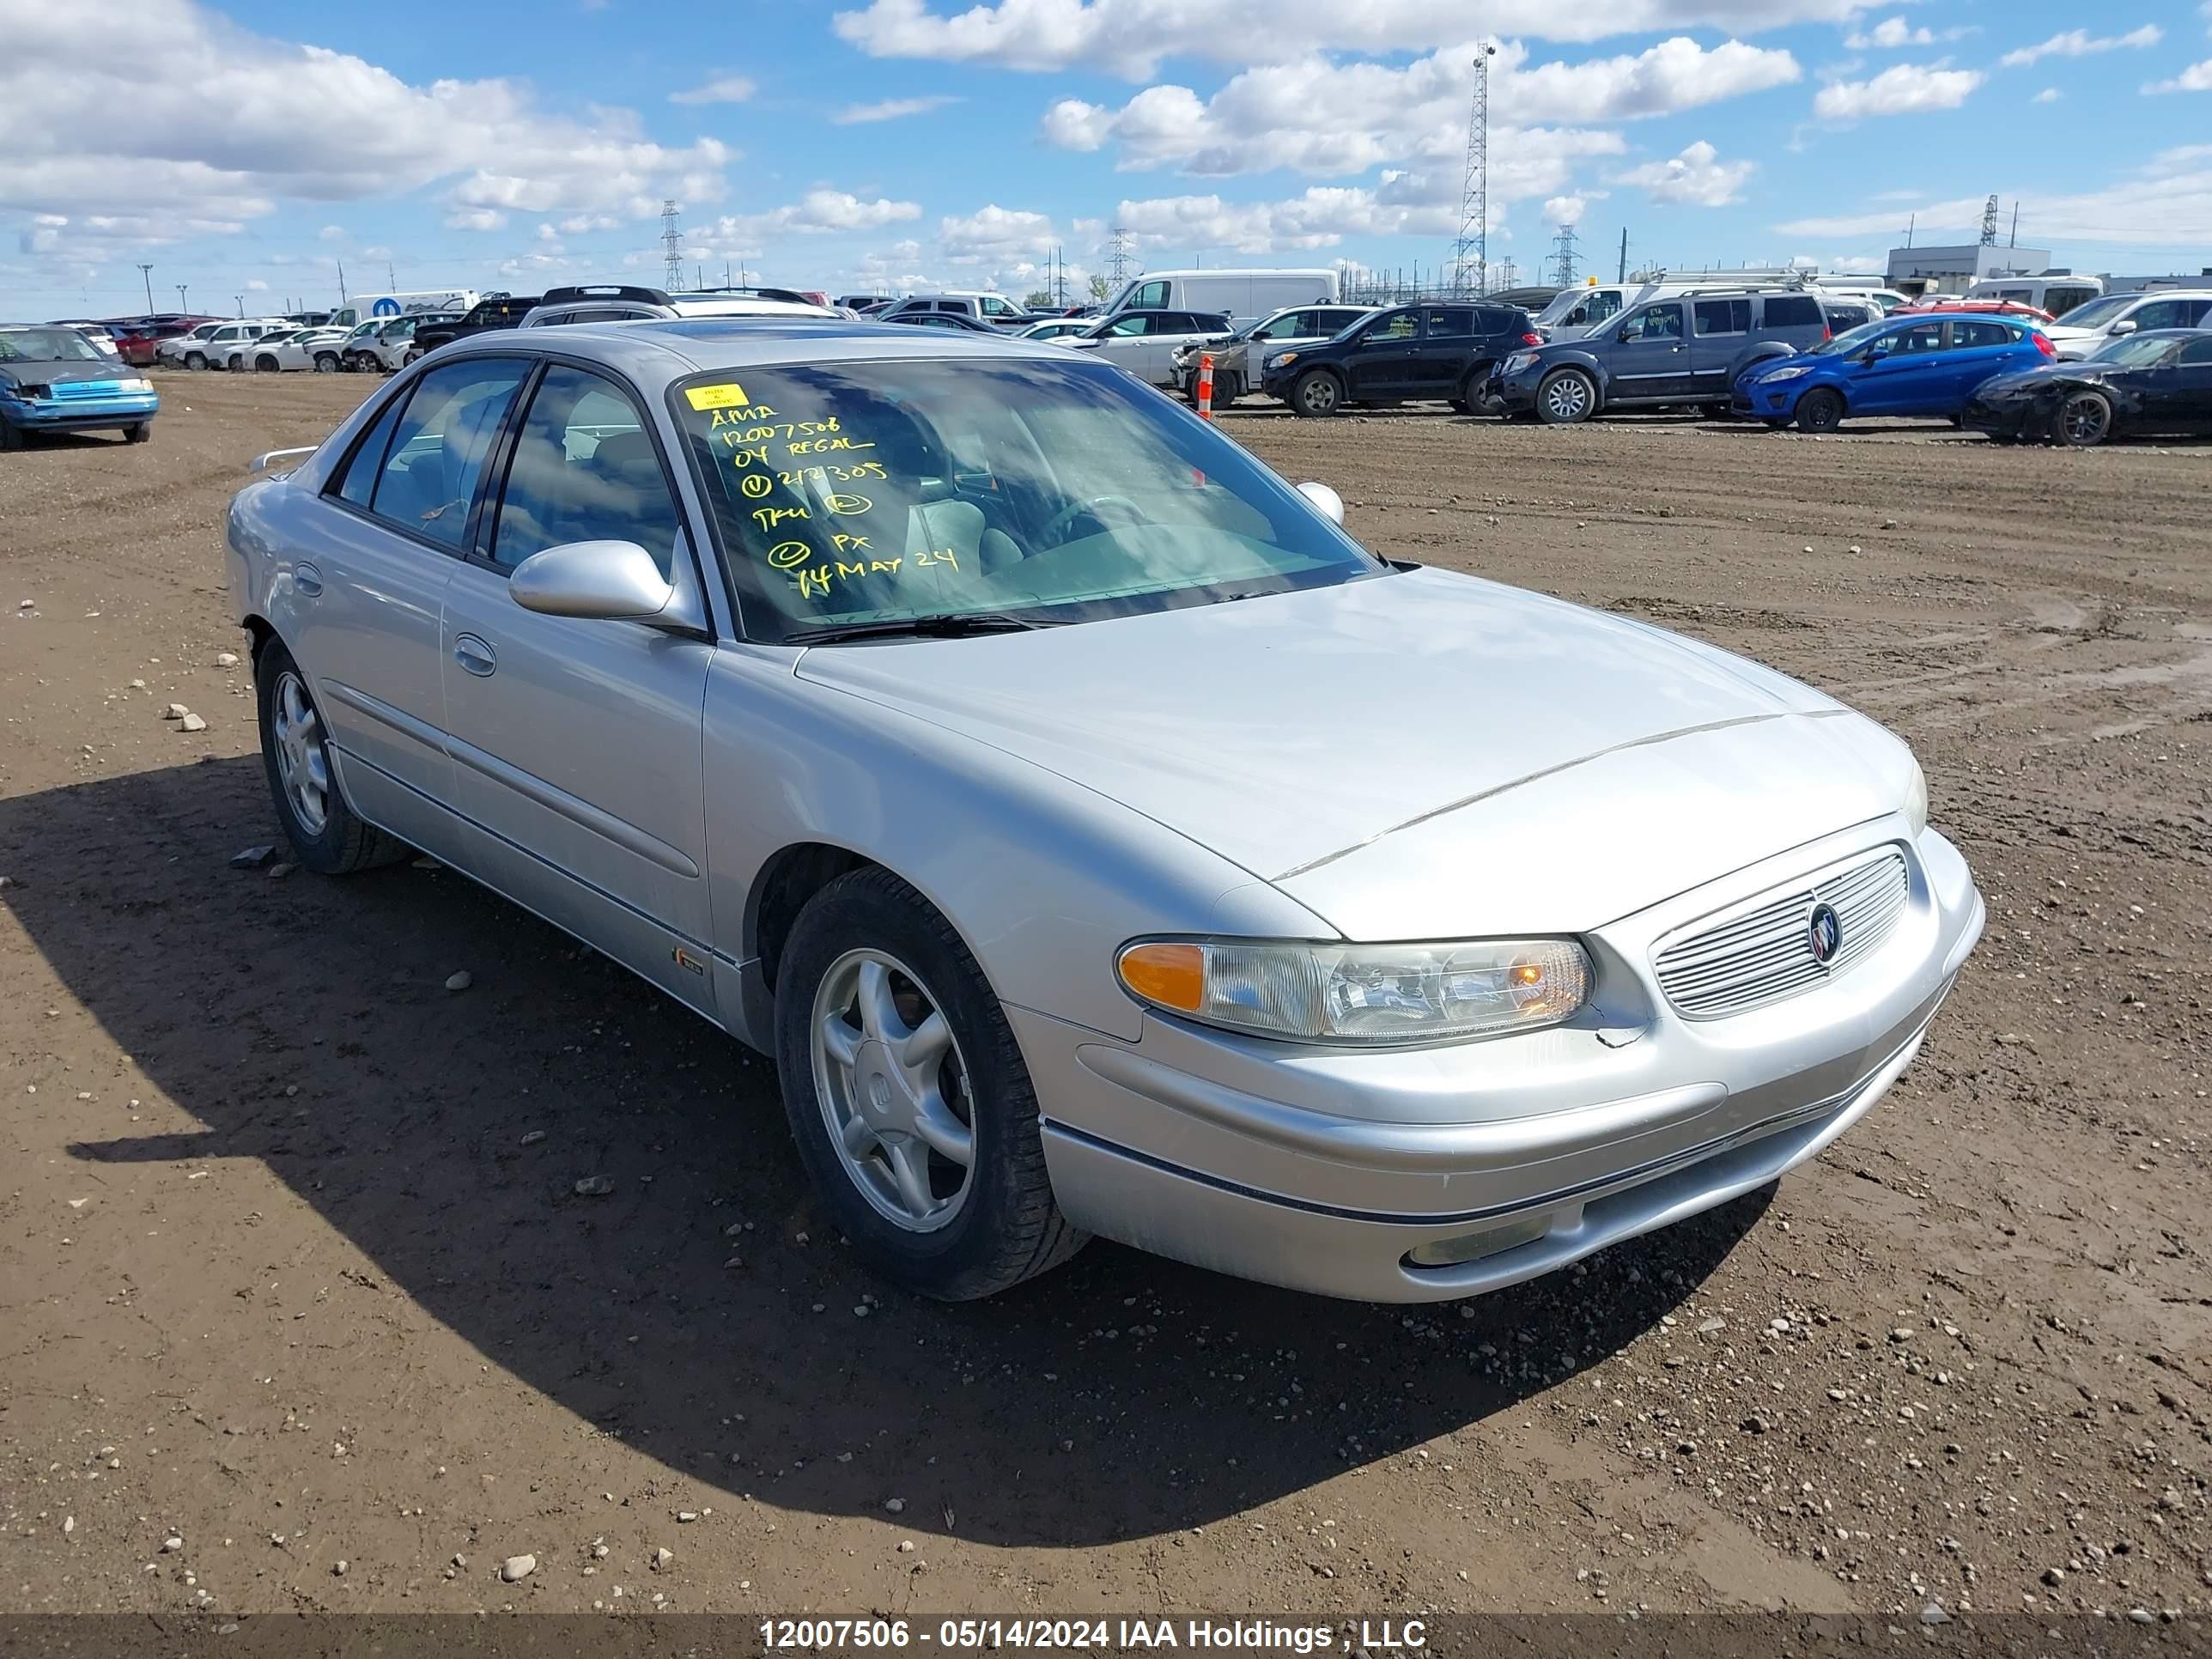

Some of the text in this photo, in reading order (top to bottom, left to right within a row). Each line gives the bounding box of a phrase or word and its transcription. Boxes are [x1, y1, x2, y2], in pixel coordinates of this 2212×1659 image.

[722, 416, 841, 447] 12007506
[735, 437, 876, 467] 04 REGAL
[831, 534, 874, 552] PX
[914, 548, 959, 573] 24
